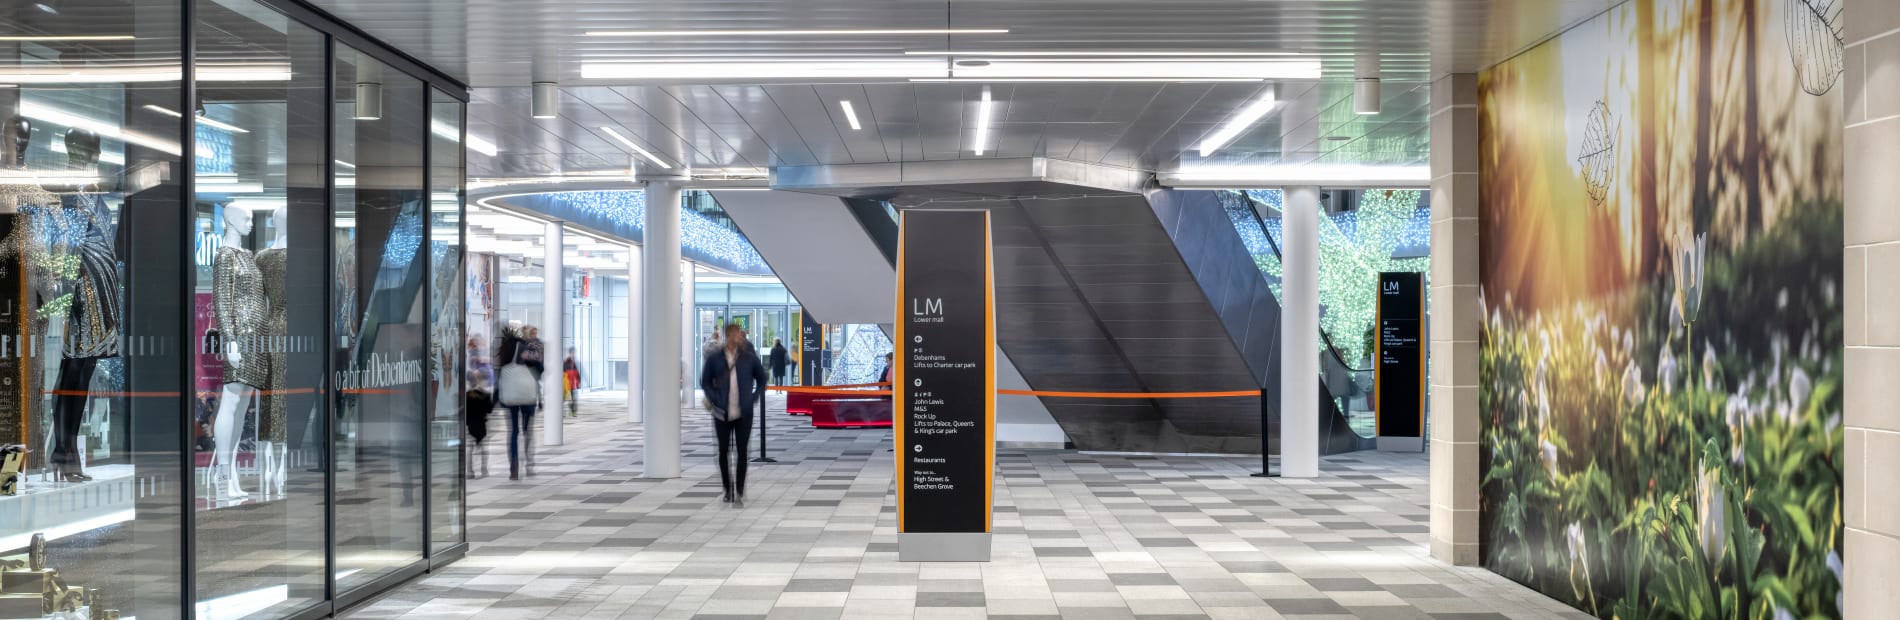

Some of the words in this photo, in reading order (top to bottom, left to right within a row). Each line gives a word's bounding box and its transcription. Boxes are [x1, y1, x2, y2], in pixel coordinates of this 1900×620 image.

[1384, 281, 1399, 291] LM
[914, 298, 943, 316] LM
[349, 360, 360, 390] bit
[362, 360, 371, 389] of
[372, 351, 422, 388] Debenhams
